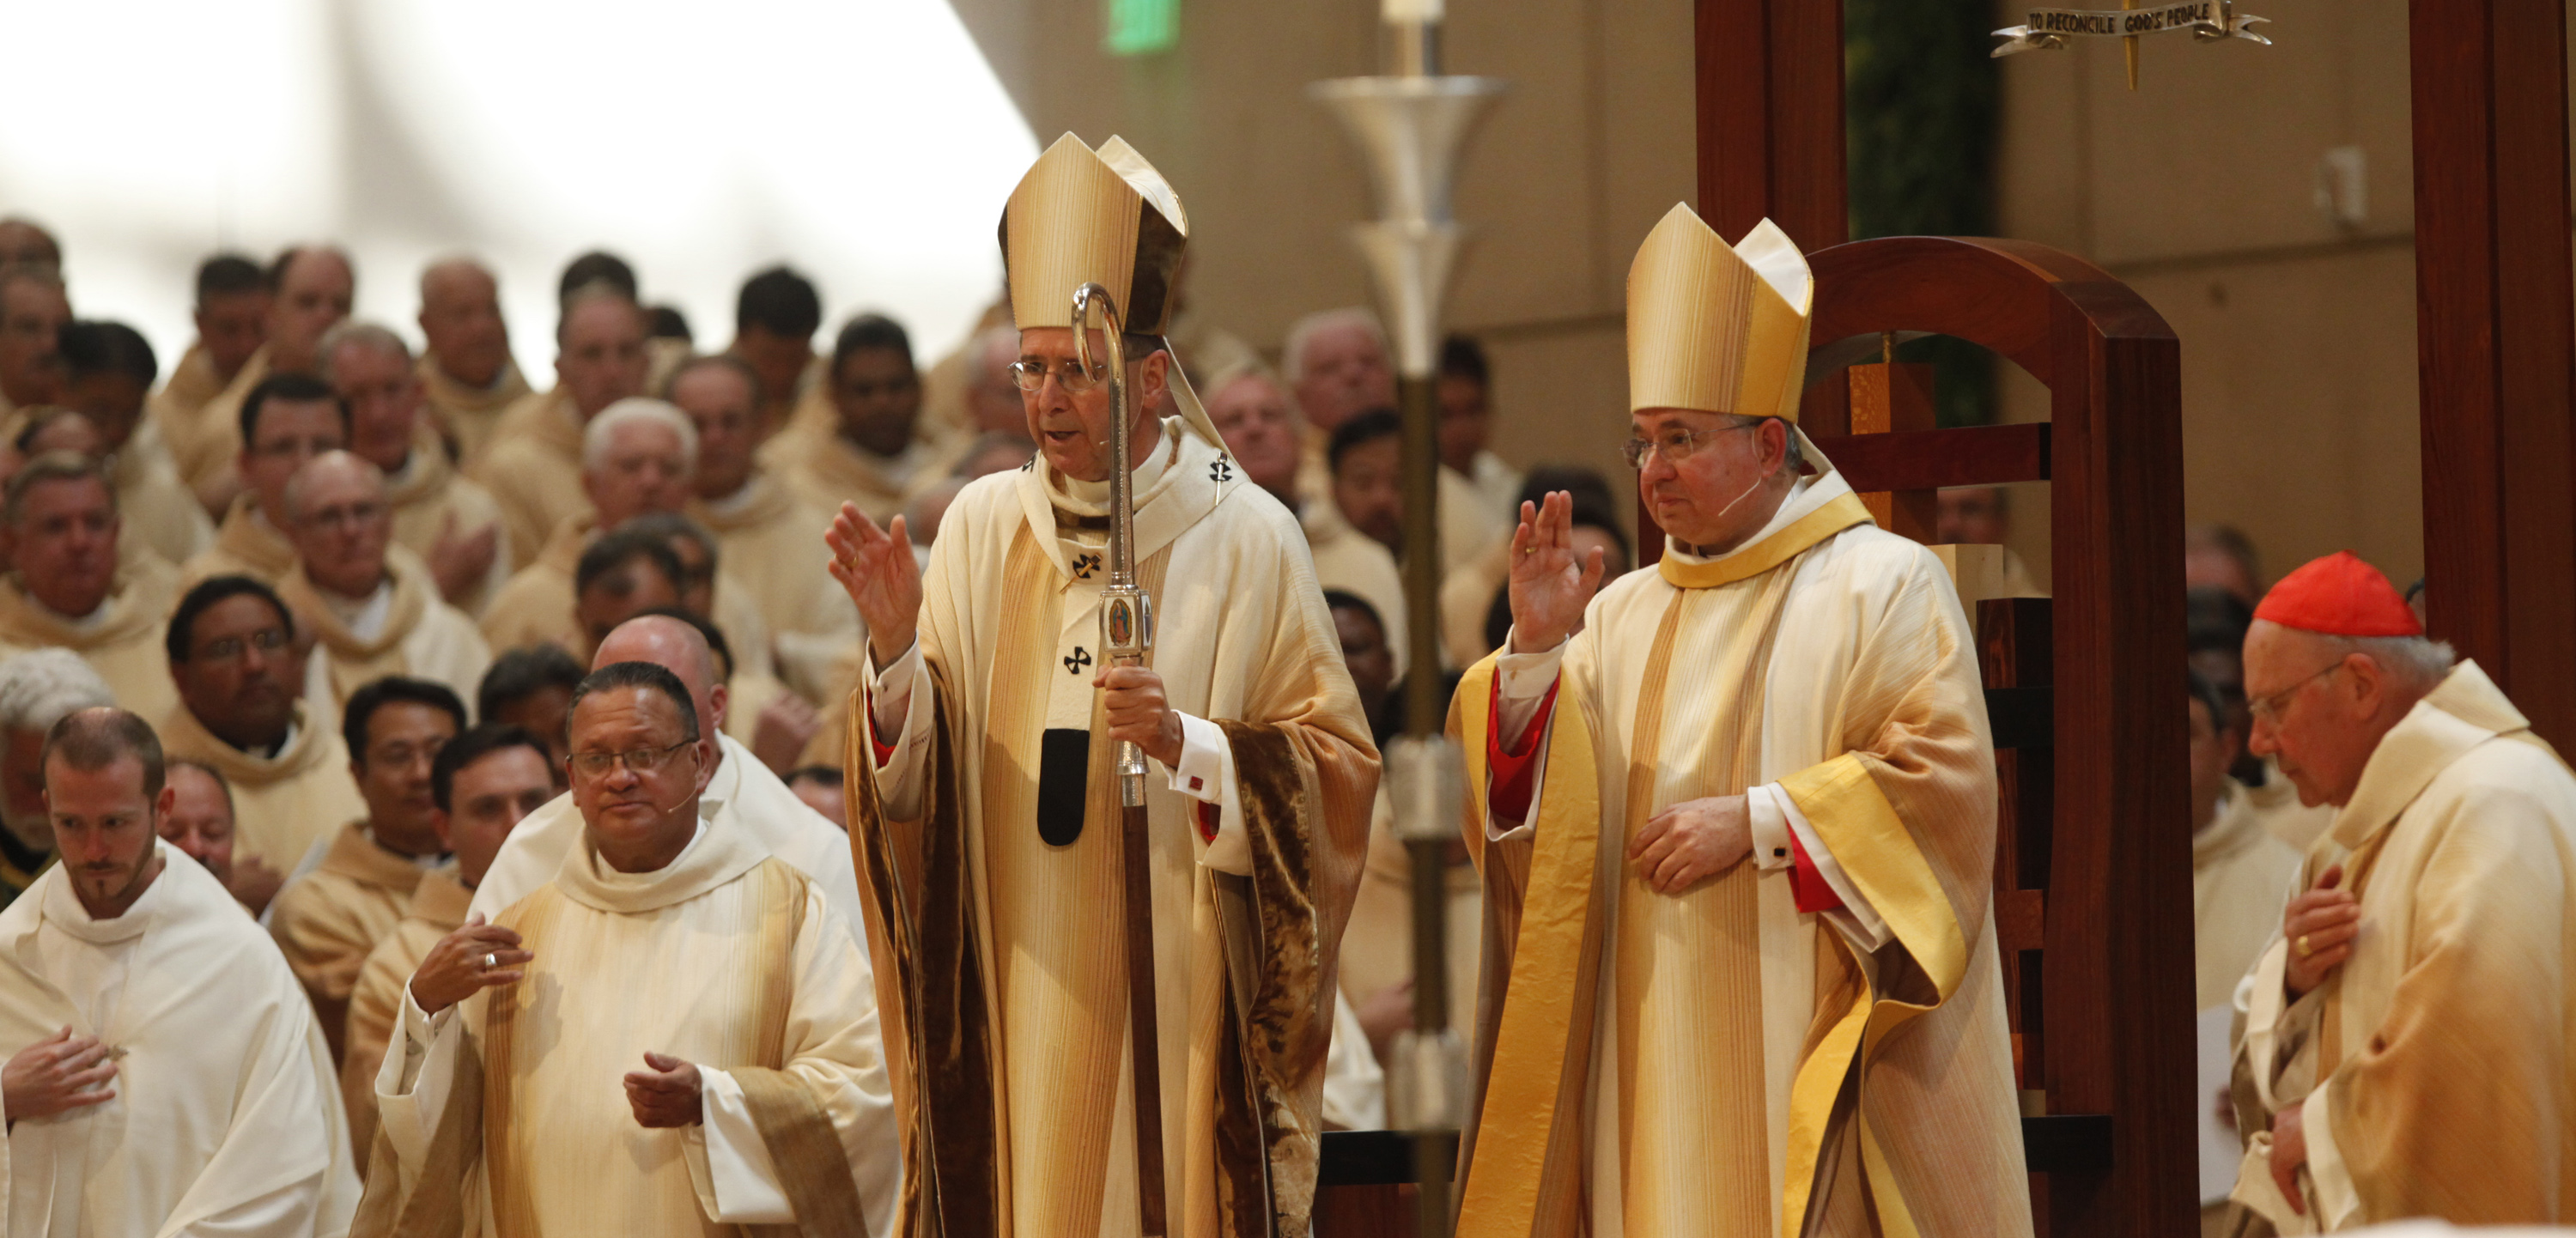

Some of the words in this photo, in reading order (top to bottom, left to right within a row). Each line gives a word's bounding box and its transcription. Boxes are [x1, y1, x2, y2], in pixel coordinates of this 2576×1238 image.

[2029, 13, 2043, 30] TO
[2046, 12, 2115, 33] RECONCILE
[2125, 11, 2162, 31] GOD'S
[2167, 3, 2209, 27] PEOPLE
